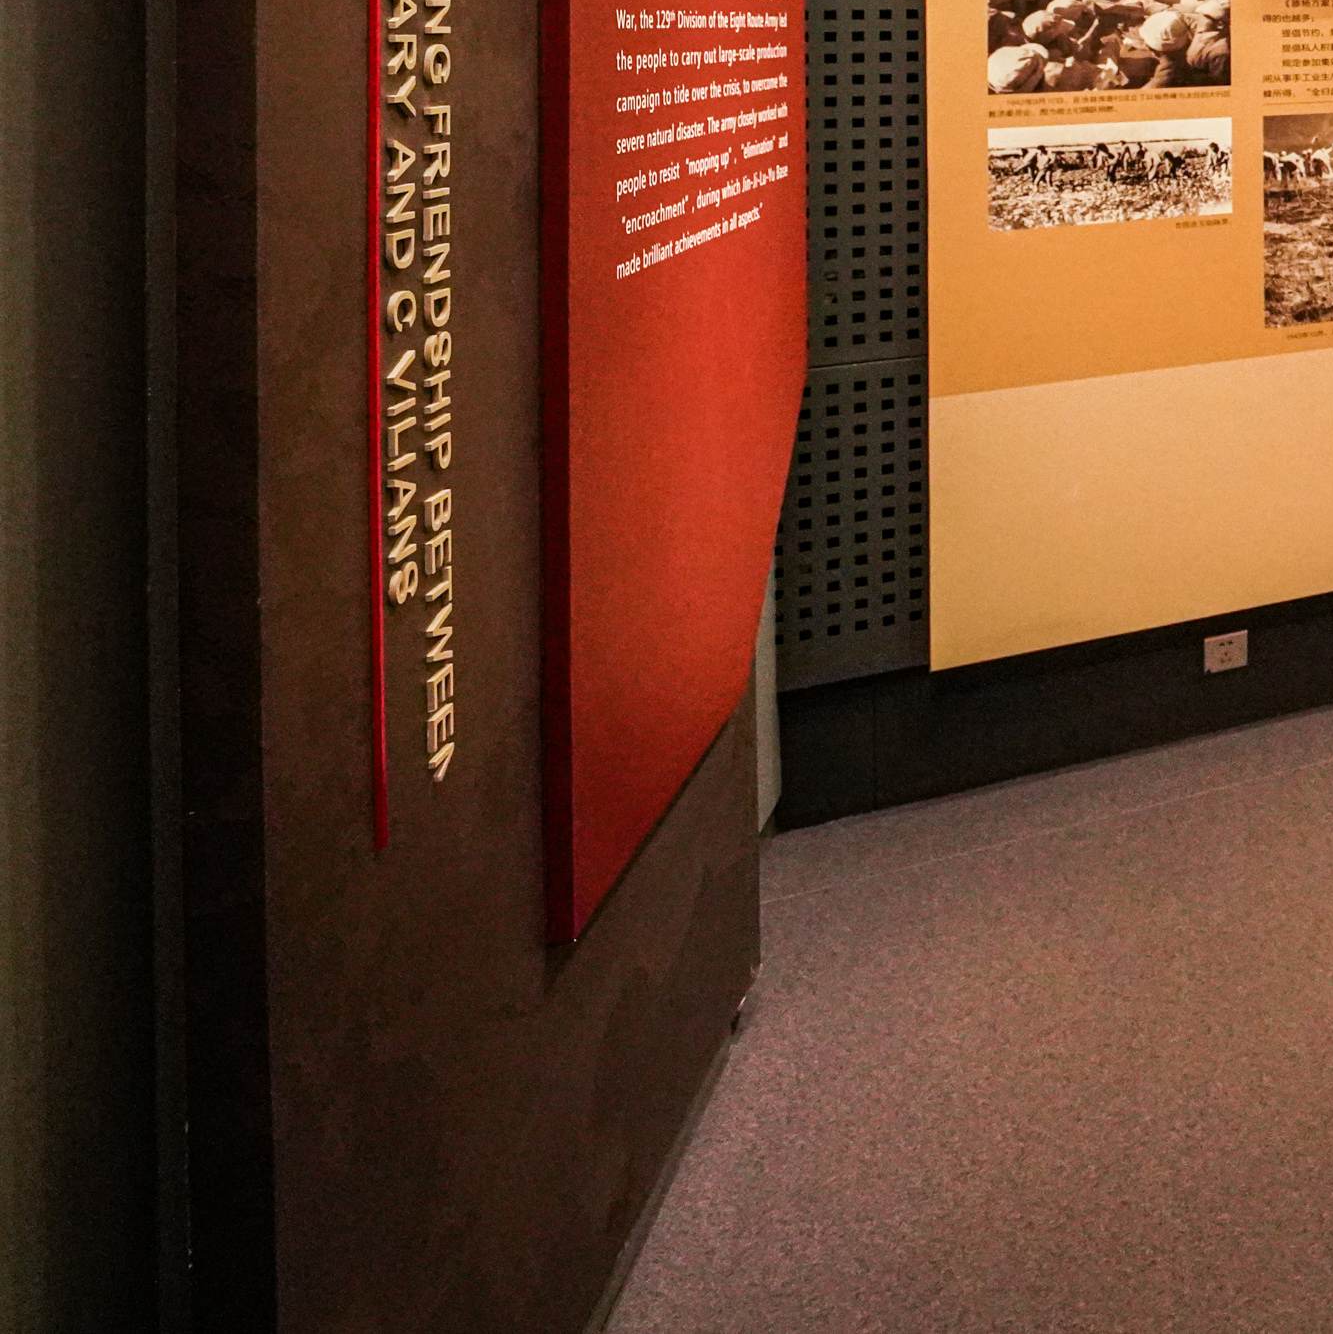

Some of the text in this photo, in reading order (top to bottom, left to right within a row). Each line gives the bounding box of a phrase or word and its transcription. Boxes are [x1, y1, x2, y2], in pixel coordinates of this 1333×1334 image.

[616, 9, 637, 31] War,
[640, 10, 654, 29] the
[656, 10, 676, 29] 129th
[678, 10, 707, 29] Division
[708, 11, 717, 29] of
[717, 11, 729, 28] the
[730, 12, 746, 33] Eight
[747, 12, 764, 28] Route
[765, 13, 778, 32] Army
[616, 42, 788, 74] the people to carry out large-scale production
[616, 72, 788, 115] campaign to tide over the crisis, to overcome the
[616, 101, 788, 154] severe natural disaster. The army closely worked with
[616, 170, 647, 202] people
[649, 169, 658, 186] to
[659, 162, 680, 182] resist
[778, 132, 788, 149] and
[697, 187, 720, 209] during
[721, 178, 741, 201] which
[776, 164, 788, 180] Base
[386, 138, 417, 269] AND
[616, 253, 641, 280] made
[642, 240, 674, 269] brilliant
[674, 222, 722, 255] achievements
[722, 217, 729, 235] in
[729, 212, 738, 232] all
[423, 105, 452, 469] FRIENDSHIP
